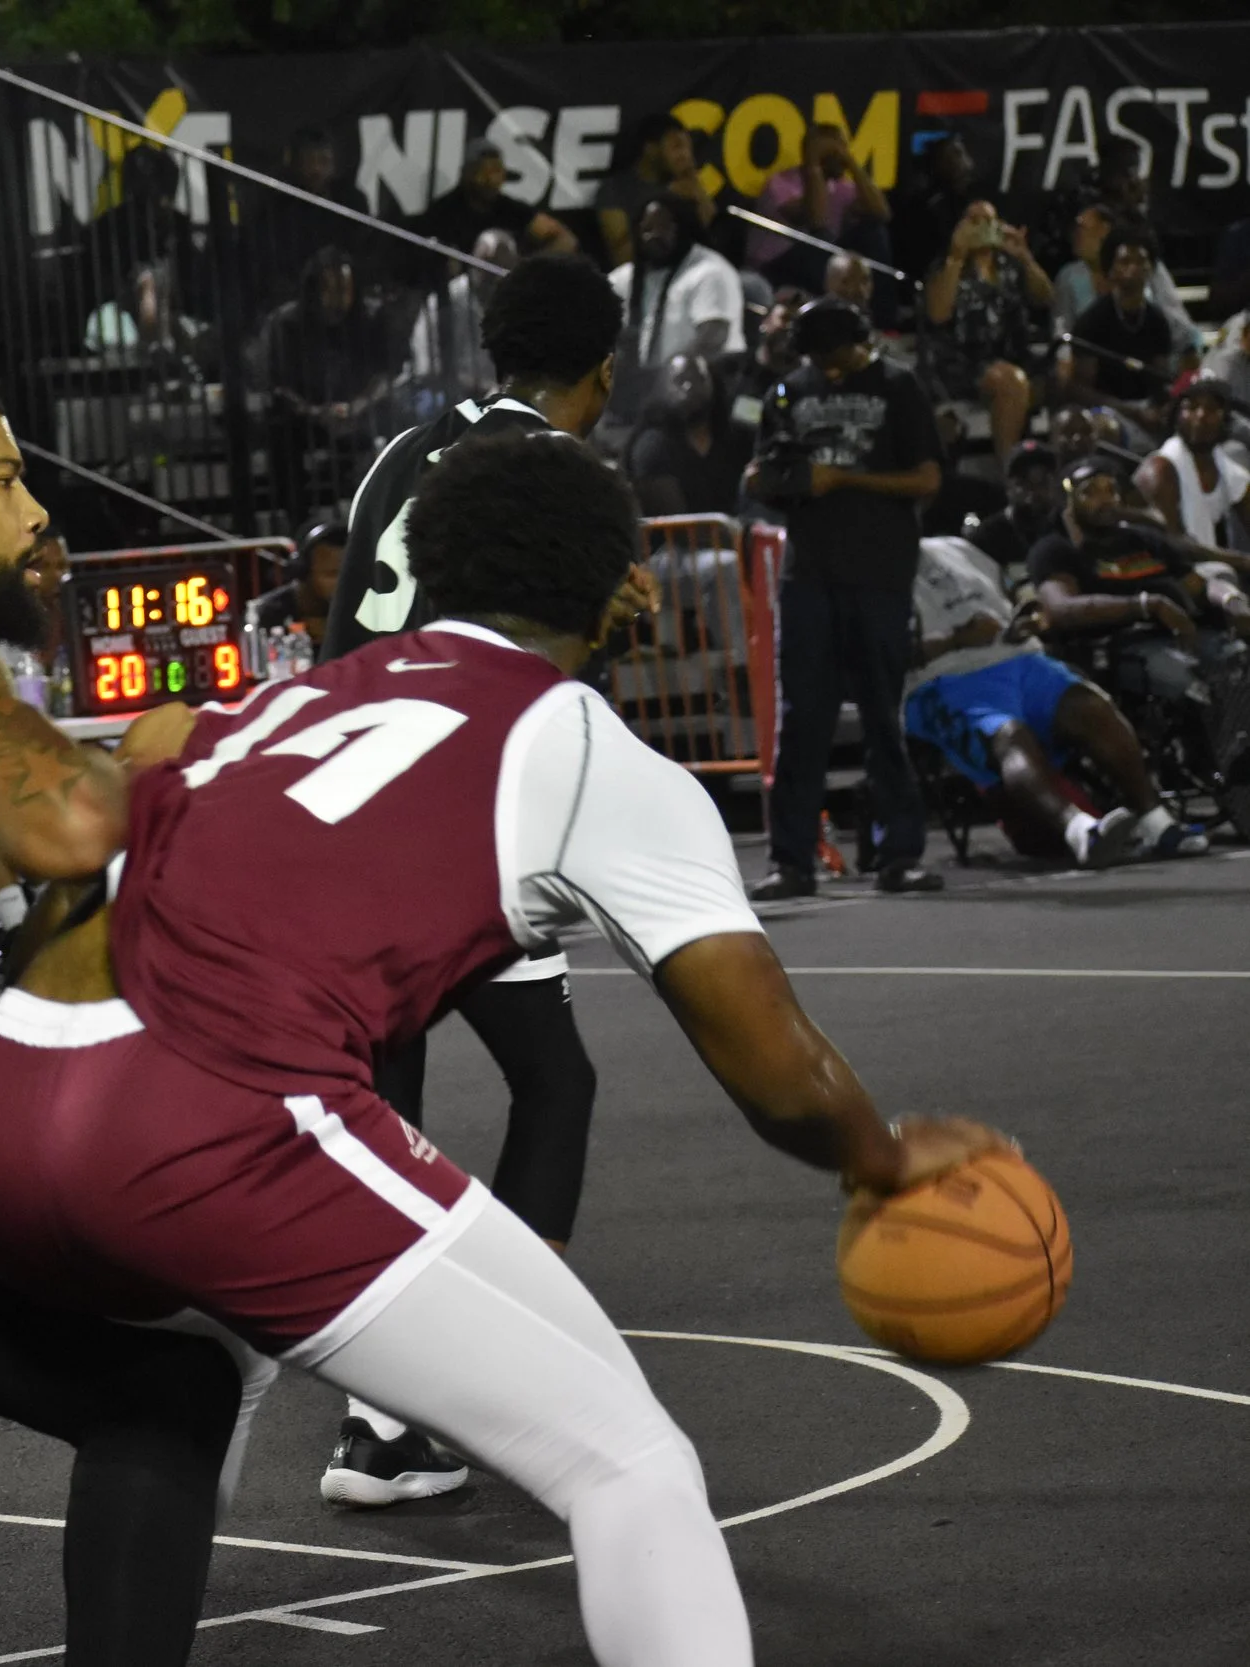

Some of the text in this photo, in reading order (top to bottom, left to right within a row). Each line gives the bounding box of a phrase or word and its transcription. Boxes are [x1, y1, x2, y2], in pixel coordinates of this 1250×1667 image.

[106, 576, 213, 631] 11:16
[96, 654, 146, 700] 20
[214, 644, 240, 689] 9
